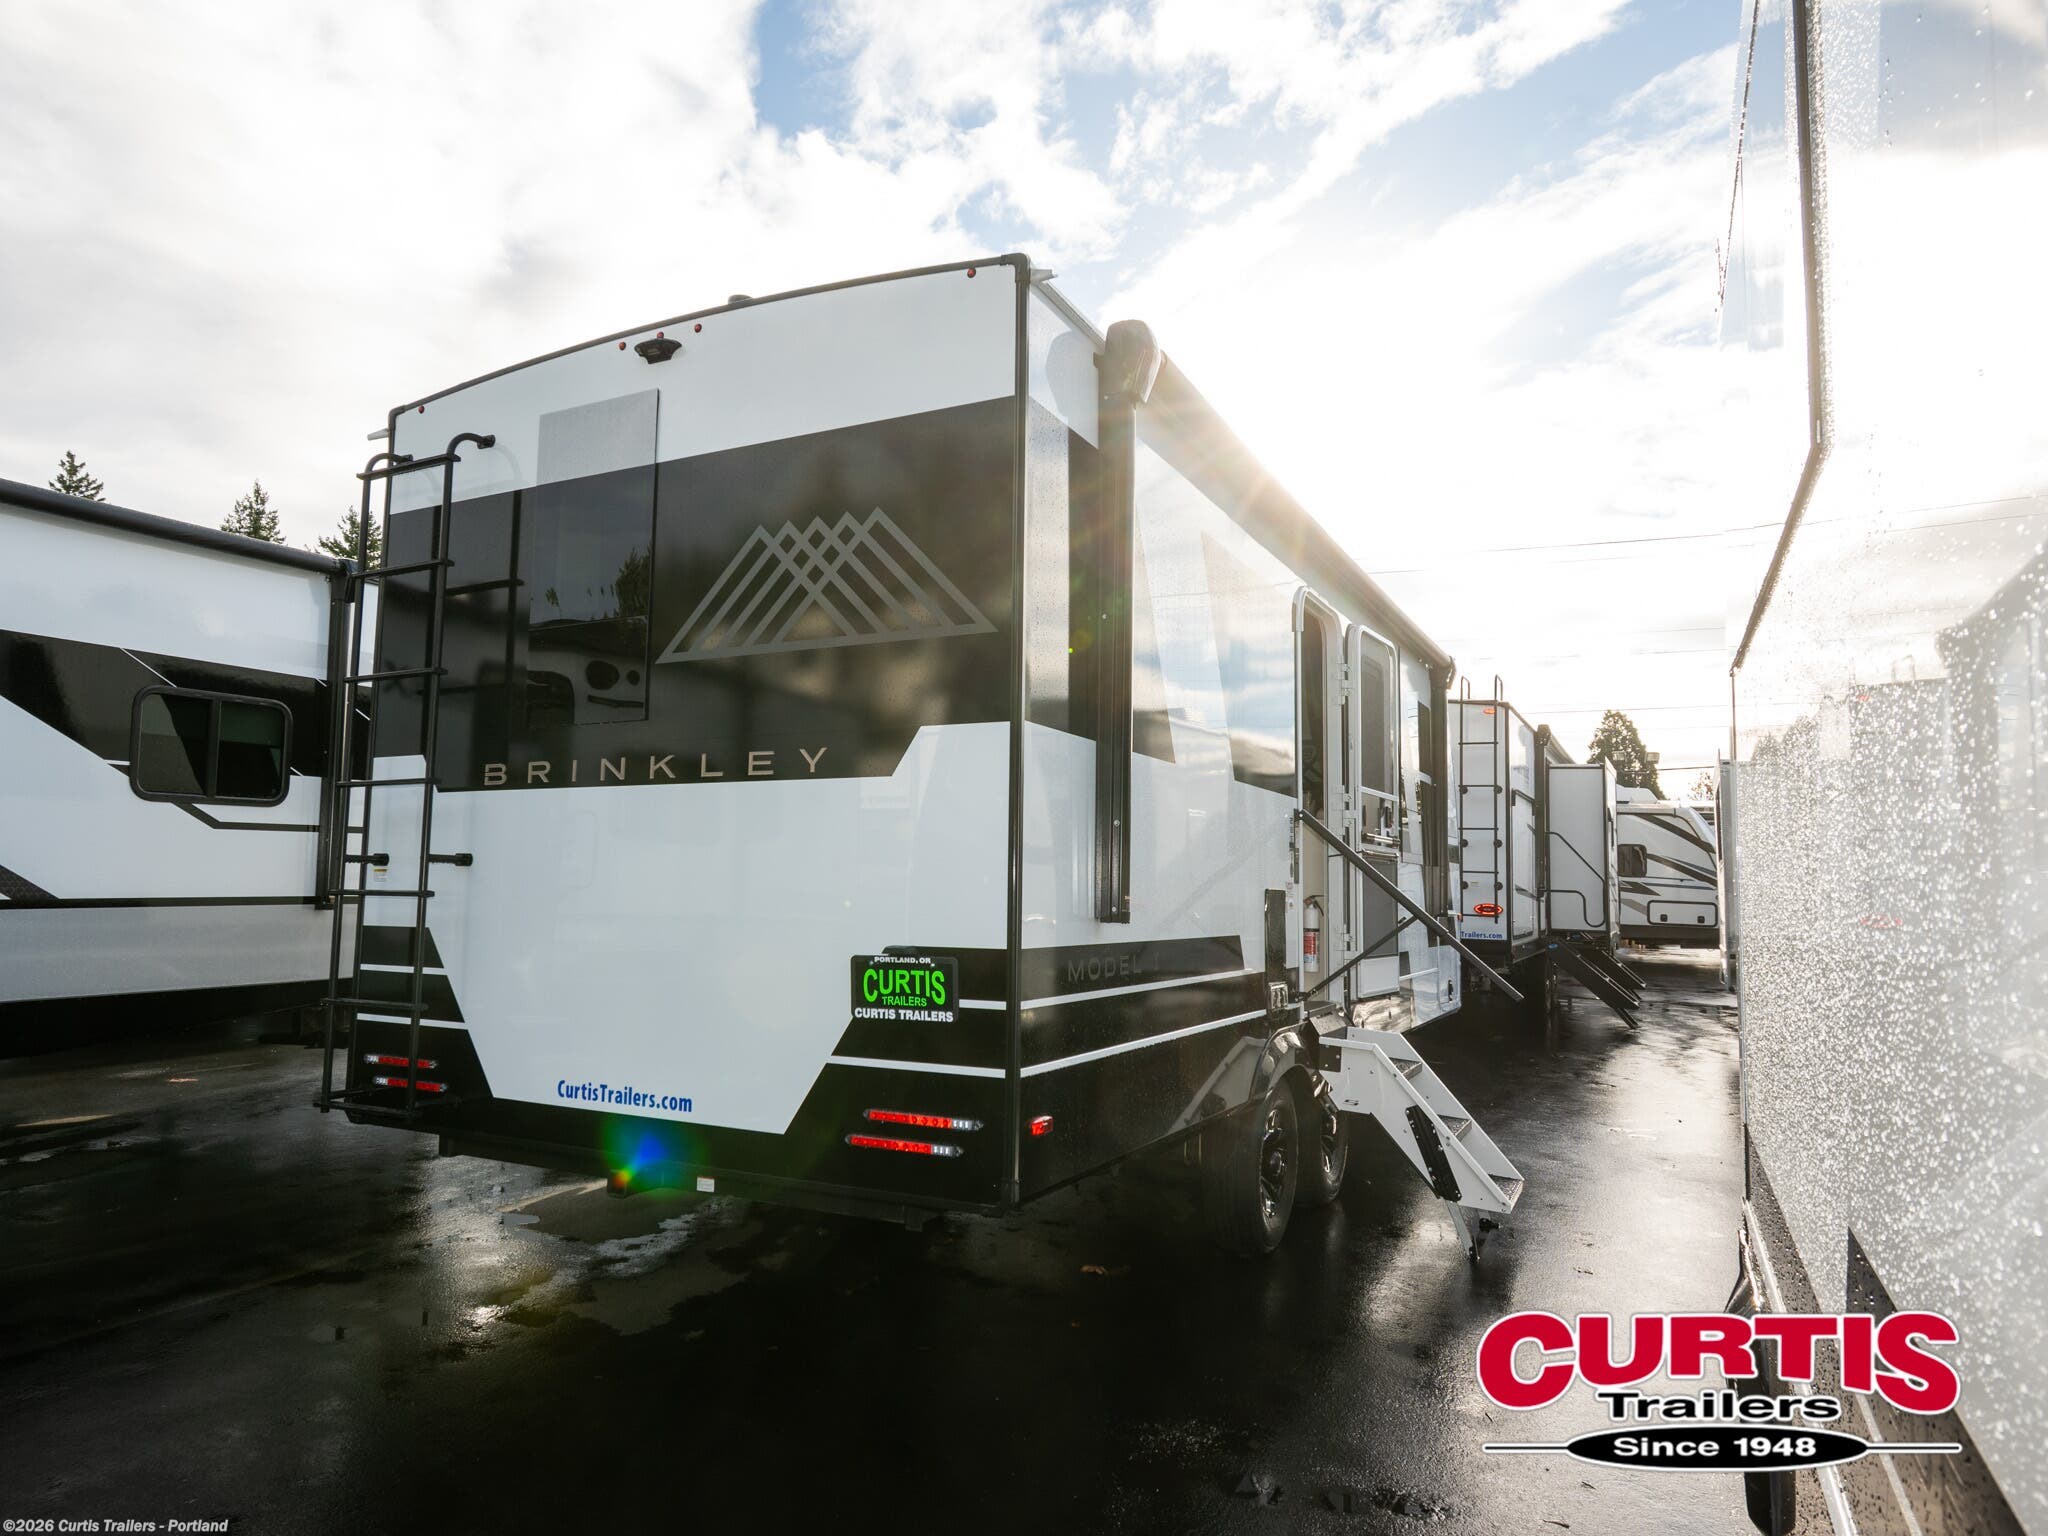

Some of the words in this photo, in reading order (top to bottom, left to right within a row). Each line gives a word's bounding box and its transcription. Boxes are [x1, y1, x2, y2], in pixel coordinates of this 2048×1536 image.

[484, 747, 827, 786] BRINKLEY
[1068, 955, 1142, 982] MODEL
[863, 968, 946, 1005] CURTIS
[882, 996, 927, 1007] TRAILERS
[854, 1007, 896, 1019] CURTIS
[898, 1009, 954, 1022] TRAILERS
[557, 1079, 693, 1112] CurtisTrailers.com
